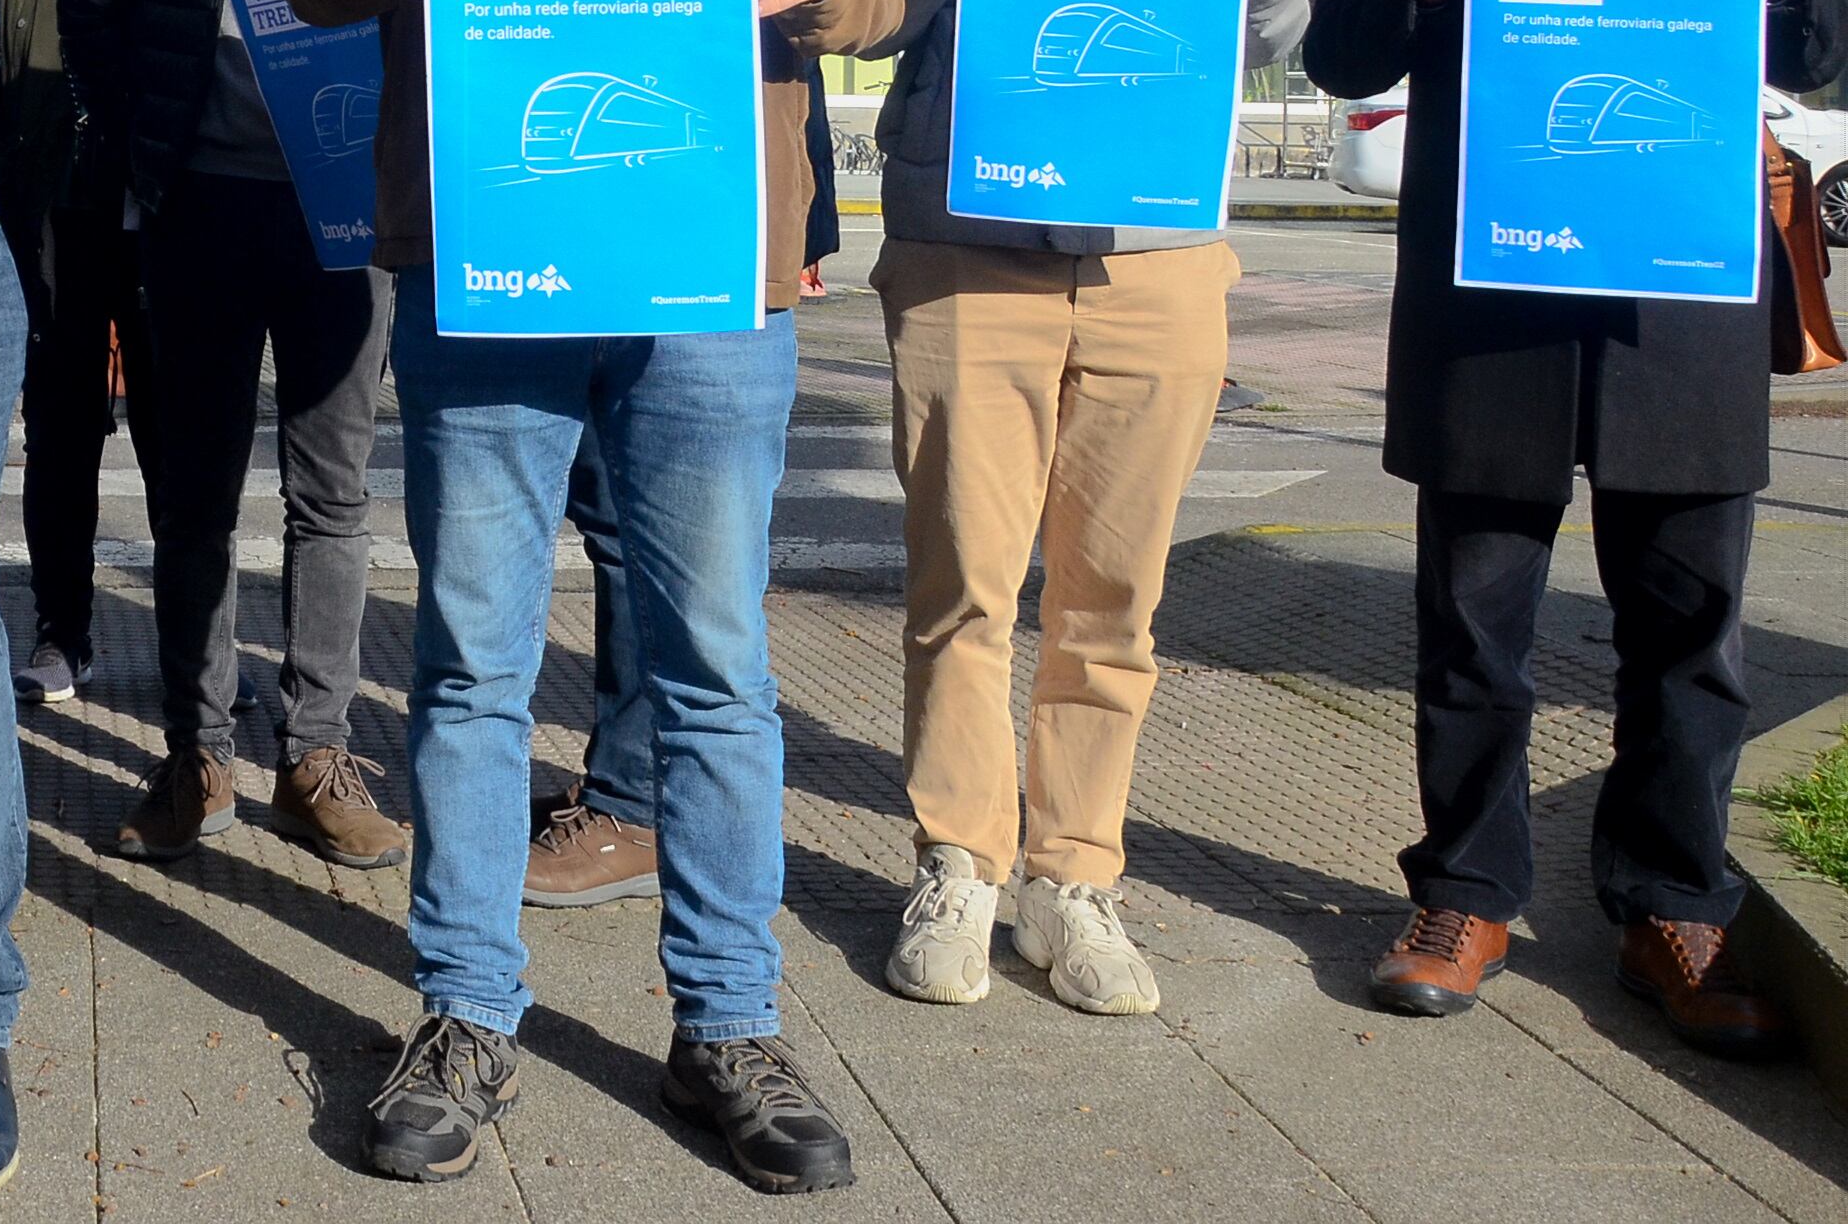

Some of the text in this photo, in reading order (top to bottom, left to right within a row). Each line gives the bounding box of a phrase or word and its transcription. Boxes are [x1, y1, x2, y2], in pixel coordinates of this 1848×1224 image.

[253, 5, 297, 30] TRE
[464, 2, 490, 17] Por
[494, 1, 531, 16] unha
[535, 1, 569, 16] rede
[572, 0, 649, 15] ferroviaria
[464, 25, 555, 40] de calidade.
[1503, 12, 1713, 34] Por unha rede ferroviaria galega
[1502, 32, 1581, 46] de calidade.
[974, 155, 1026, 188] bng
[318, 220, 352, 243] bng
[1490, 221, 1543, 253] bng
[462, 262, 523, 298] bng
